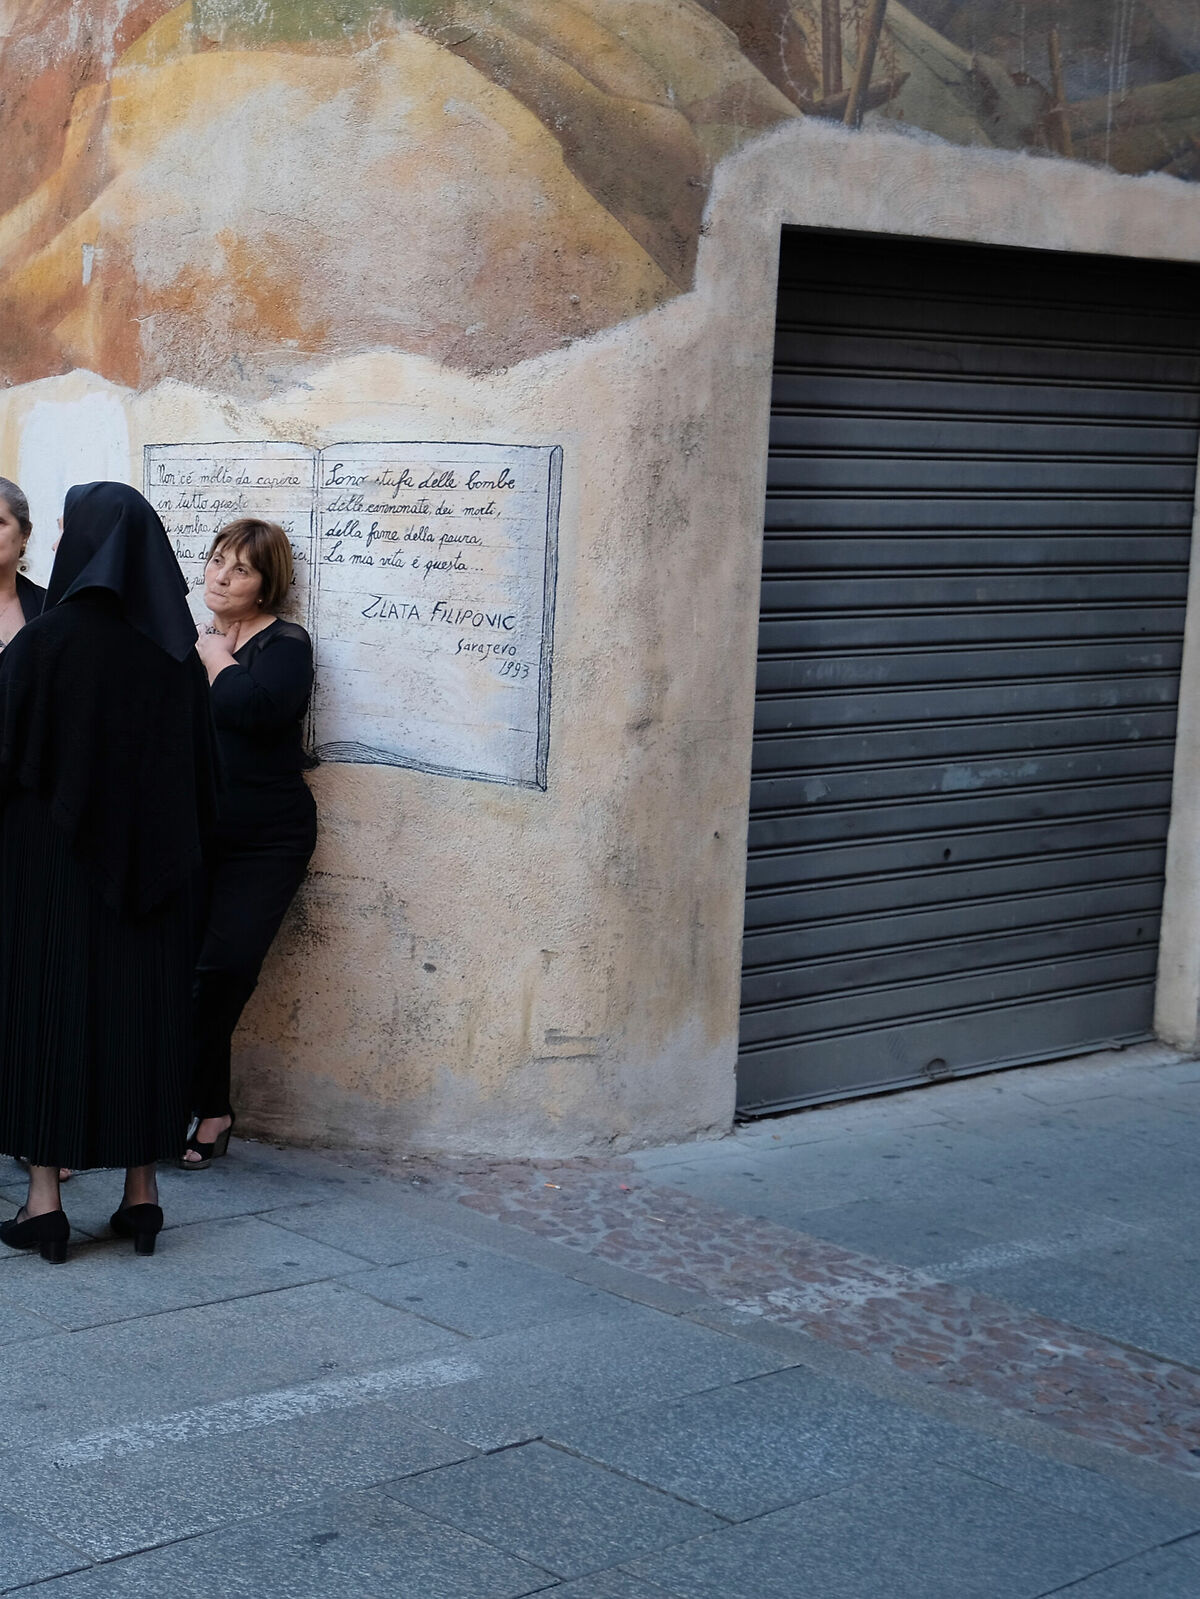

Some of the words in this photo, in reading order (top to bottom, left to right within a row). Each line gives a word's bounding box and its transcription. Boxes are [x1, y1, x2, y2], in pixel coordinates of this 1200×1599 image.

[157, 464, 175, 485] Non
[200, 466, 232, 484] molto
[236, 467, 251, 485] da
[325, 463, 369, 487] Sono
[418, 470, 457, 489] delle
[465, 467, 516, 490] bombe
[157, 499, 173, 510] in
[175, 492, 208, 510] tutto
[326, 494, 363, 513] delle
[435, 499, 454, 516] dei
[325, 521, 363, 539] della
[366, 522, 400, 547] fame
[404, 525, 435, 543] della
[323, 541, 346, 563] La
[350, 554, 375, 567] mia
[379, 549, 406, 568] vita
[361, 593, 420, 621] ZLATA
[431, 601, 518, 631] FILIPOVIC
[499, 659, 530, 679] 1993
